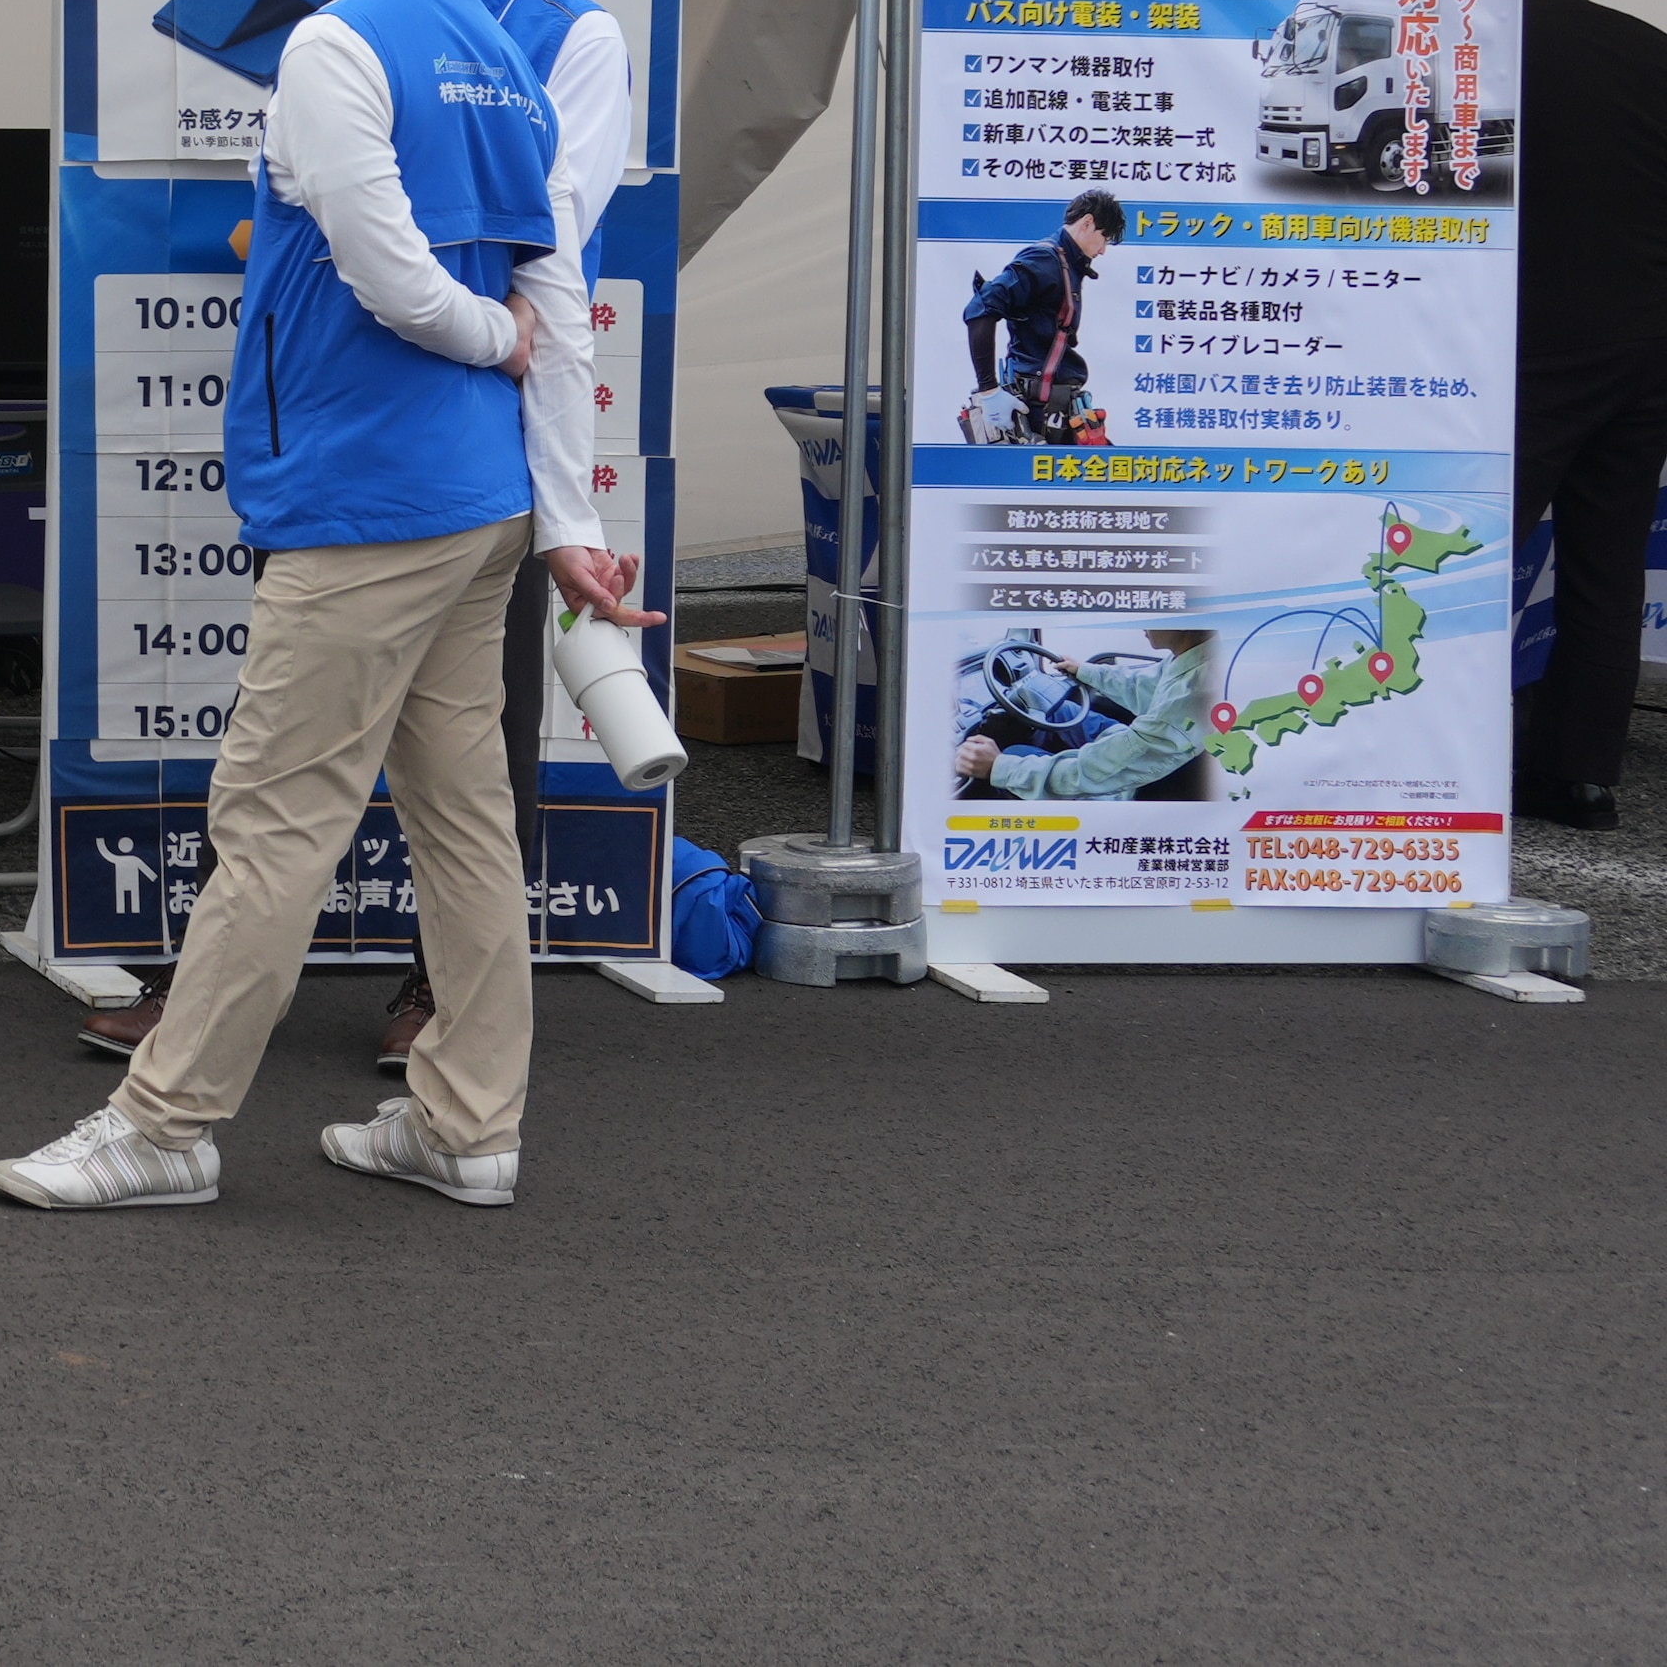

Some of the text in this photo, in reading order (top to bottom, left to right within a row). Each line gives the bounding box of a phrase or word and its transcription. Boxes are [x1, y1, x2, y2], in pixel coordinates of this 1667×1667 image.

[966, 0, 1202, 30] バス向け電装・架装
[986, 55, 1154, 78] ワンマン機器取付
[984, 89, 1174, 112] 追加配線・電装工事
[983, 123, 1215, 148] 新車バスの二次架装一式
[982, 158, 1236, 183] その他ご要望に応じて対応
[1135, 211, 1490, 243] トラック・商用車向け機器取付
[1158, 266, 1240, 286] カーナビ
[1261, 267, 1321, 288] カメラ
[1342, 268, 1422, 289] モニター
[1157, 300, 1303, 322] 電装品各種取付
[1159, 334, 1343, 355] ドライブレコーダー
[136, 375, 231, 407] 11:0
[1134, 373, 1479, 398] 幼稚園バス置き去り防止装置を始め、
[1134, 407, 1353, 432] 各種機器取付実績あり。
[1031, 454, 1391, 484] 日本全国対応ネットワークあり
[1007, 510, 1170, 529] 確かな技術を現地で
[135, 544, 252, 576] 13:00
[971, 549, 1204, 570] バスも車も専門家がサポート
[989, 589, 1186, 610] どこでも安心の出張作業
[134, 623, 250, 656] 14:00
[988, 818, 1037, 829] お問合せ
[166, 831, 201, 867] 近
[1085, 837, 1230, 855] 大和産業株式会社
[1246, 836, 1460, 861] TEL:048-729-6335
[1138, 859, 1229, 872] 産業機械営業部
[1015, 876, 1181, 890] 埼玉県さいたま市北区宮原町
[1184, 877, 1229, 889] 2-53-12
[1245, 868, 1463, 893] FAX:048-729-6206
